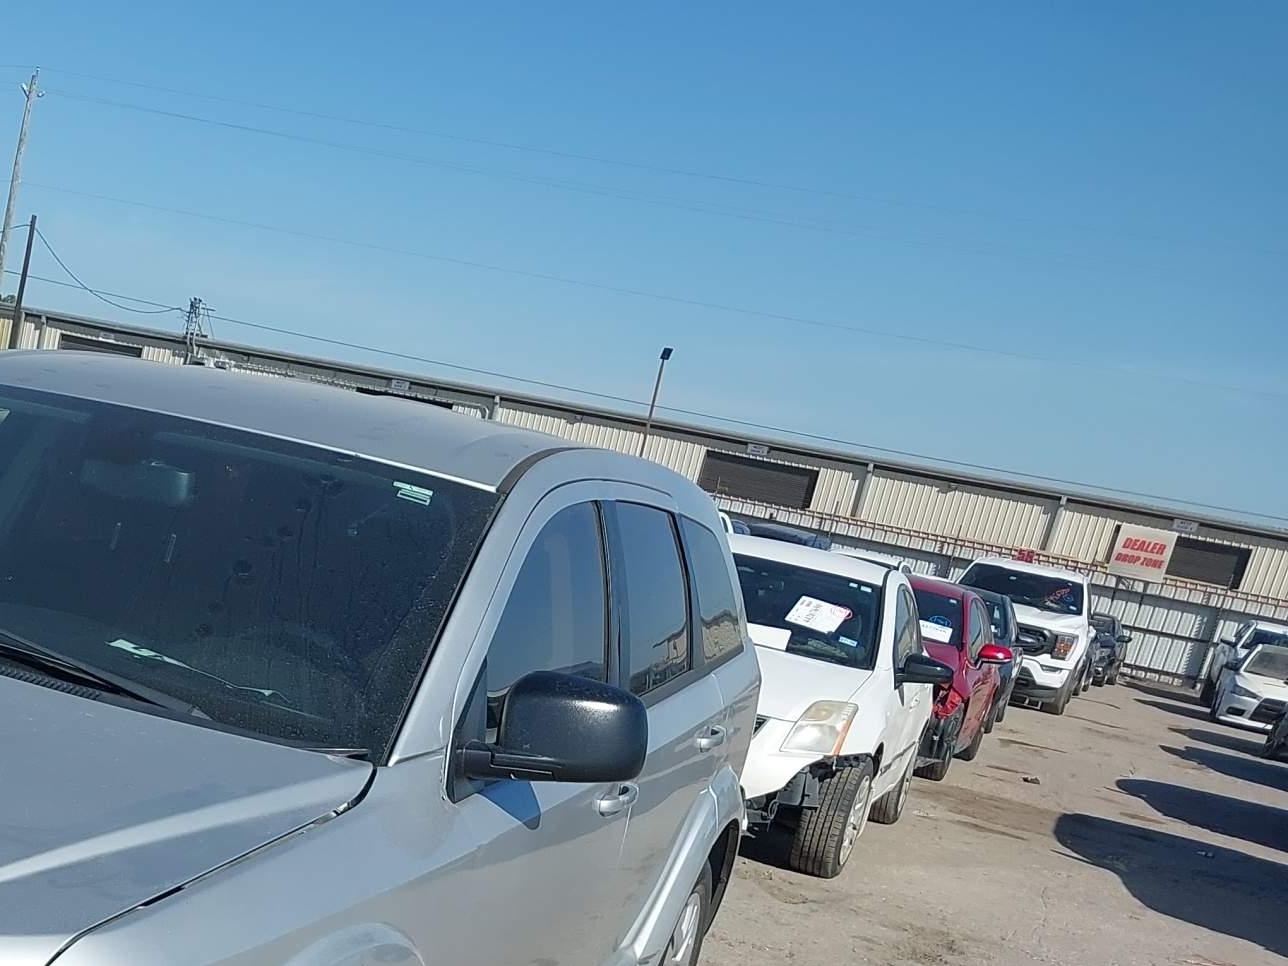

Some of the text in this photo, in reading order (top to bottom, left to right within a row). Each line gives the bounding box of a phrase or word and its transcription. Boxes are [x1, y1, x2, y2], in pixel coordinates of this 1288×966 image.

[1122, 537, 1167, 556] DEALER
[1115, 552, 1165, 570] DROP ZONE
